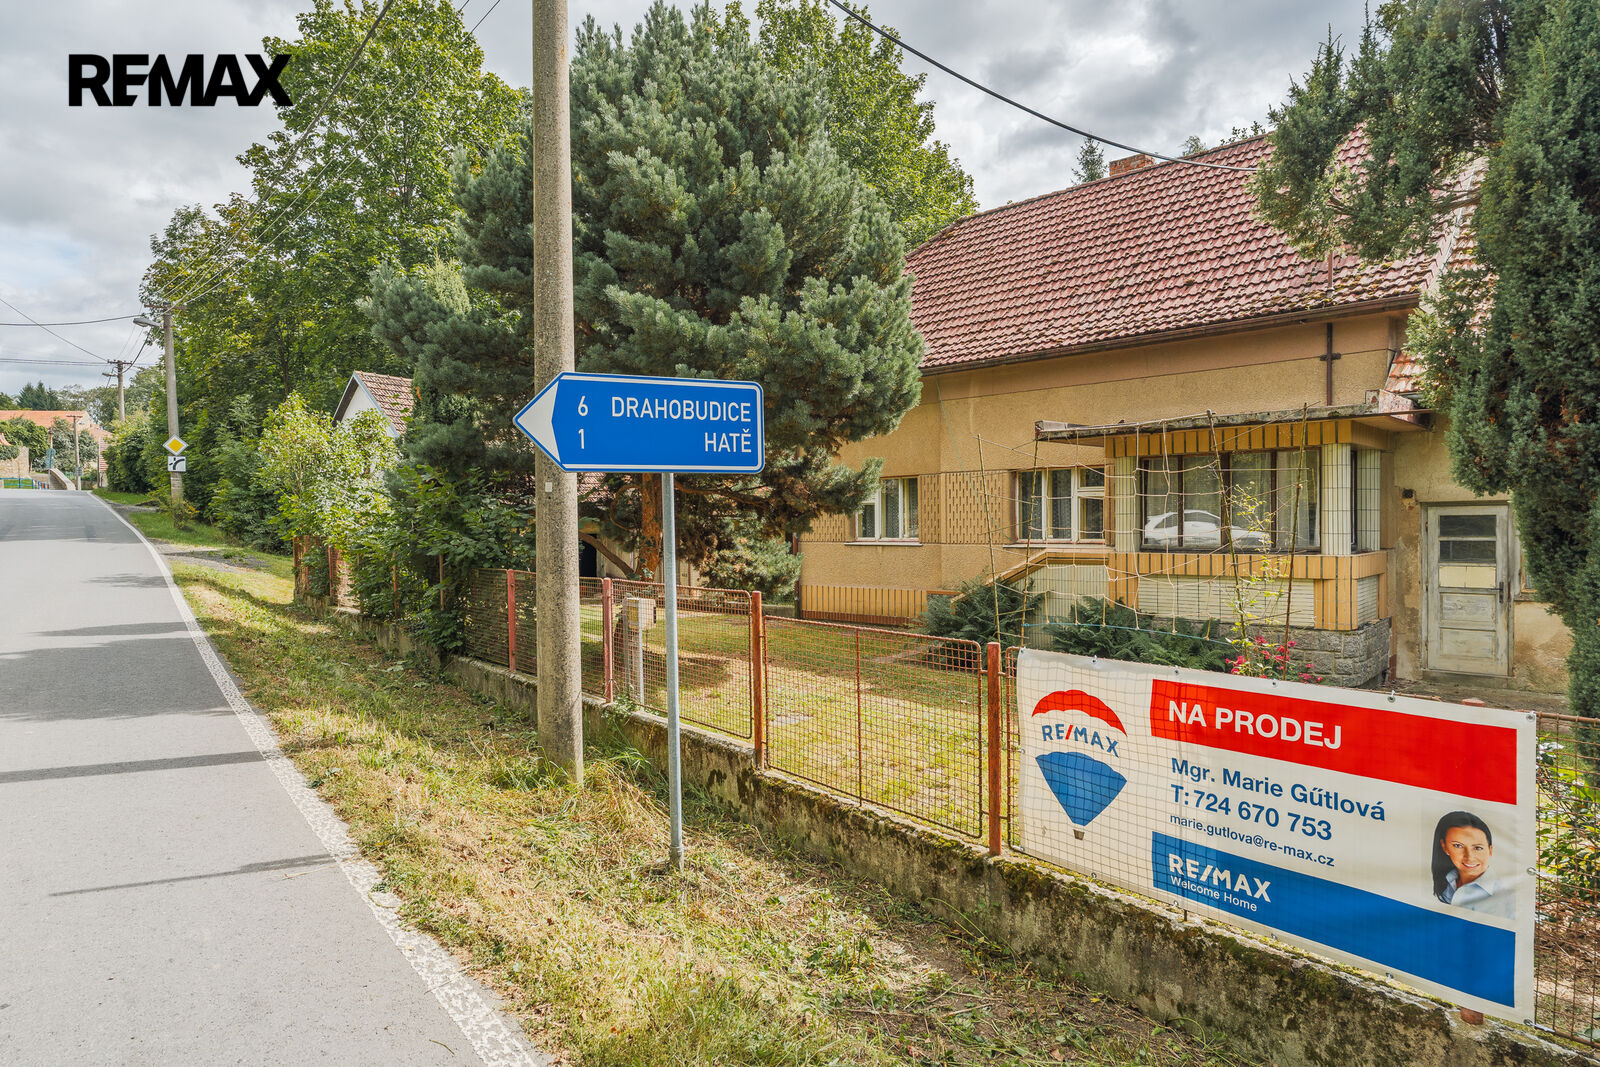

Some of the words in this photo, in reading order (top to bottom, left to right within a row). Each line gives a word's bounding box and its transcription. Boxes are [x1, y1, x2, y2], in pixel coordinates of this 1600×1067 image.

[577, 395, 589, 417] 6
[611, 396, 751, 422] DRAHOBUDICE
[578, 428, 585, 449] 1
[704, 428, 752, 452] HATĚ
[1041, 723, 1119, 758] RE/MAX
[1169, 700, 1207, 727] NA
[1215, 707, 1342, 749] PRODEJ
[1171, 757, 1215, 782] Mgr.
[1222, 768, 1283, 797] Marie
[1169, 815, 1335, 867] marie.gutlova@re-max.cz
[1238, 801, 1279, 827] 670
[1287, 812, 1332, 841] 753
[1168, 853, 1272, 903] RE/MAX
[1170, 875, 1221, 900] Welcome
[1223, 892, 1258, 912] Home
